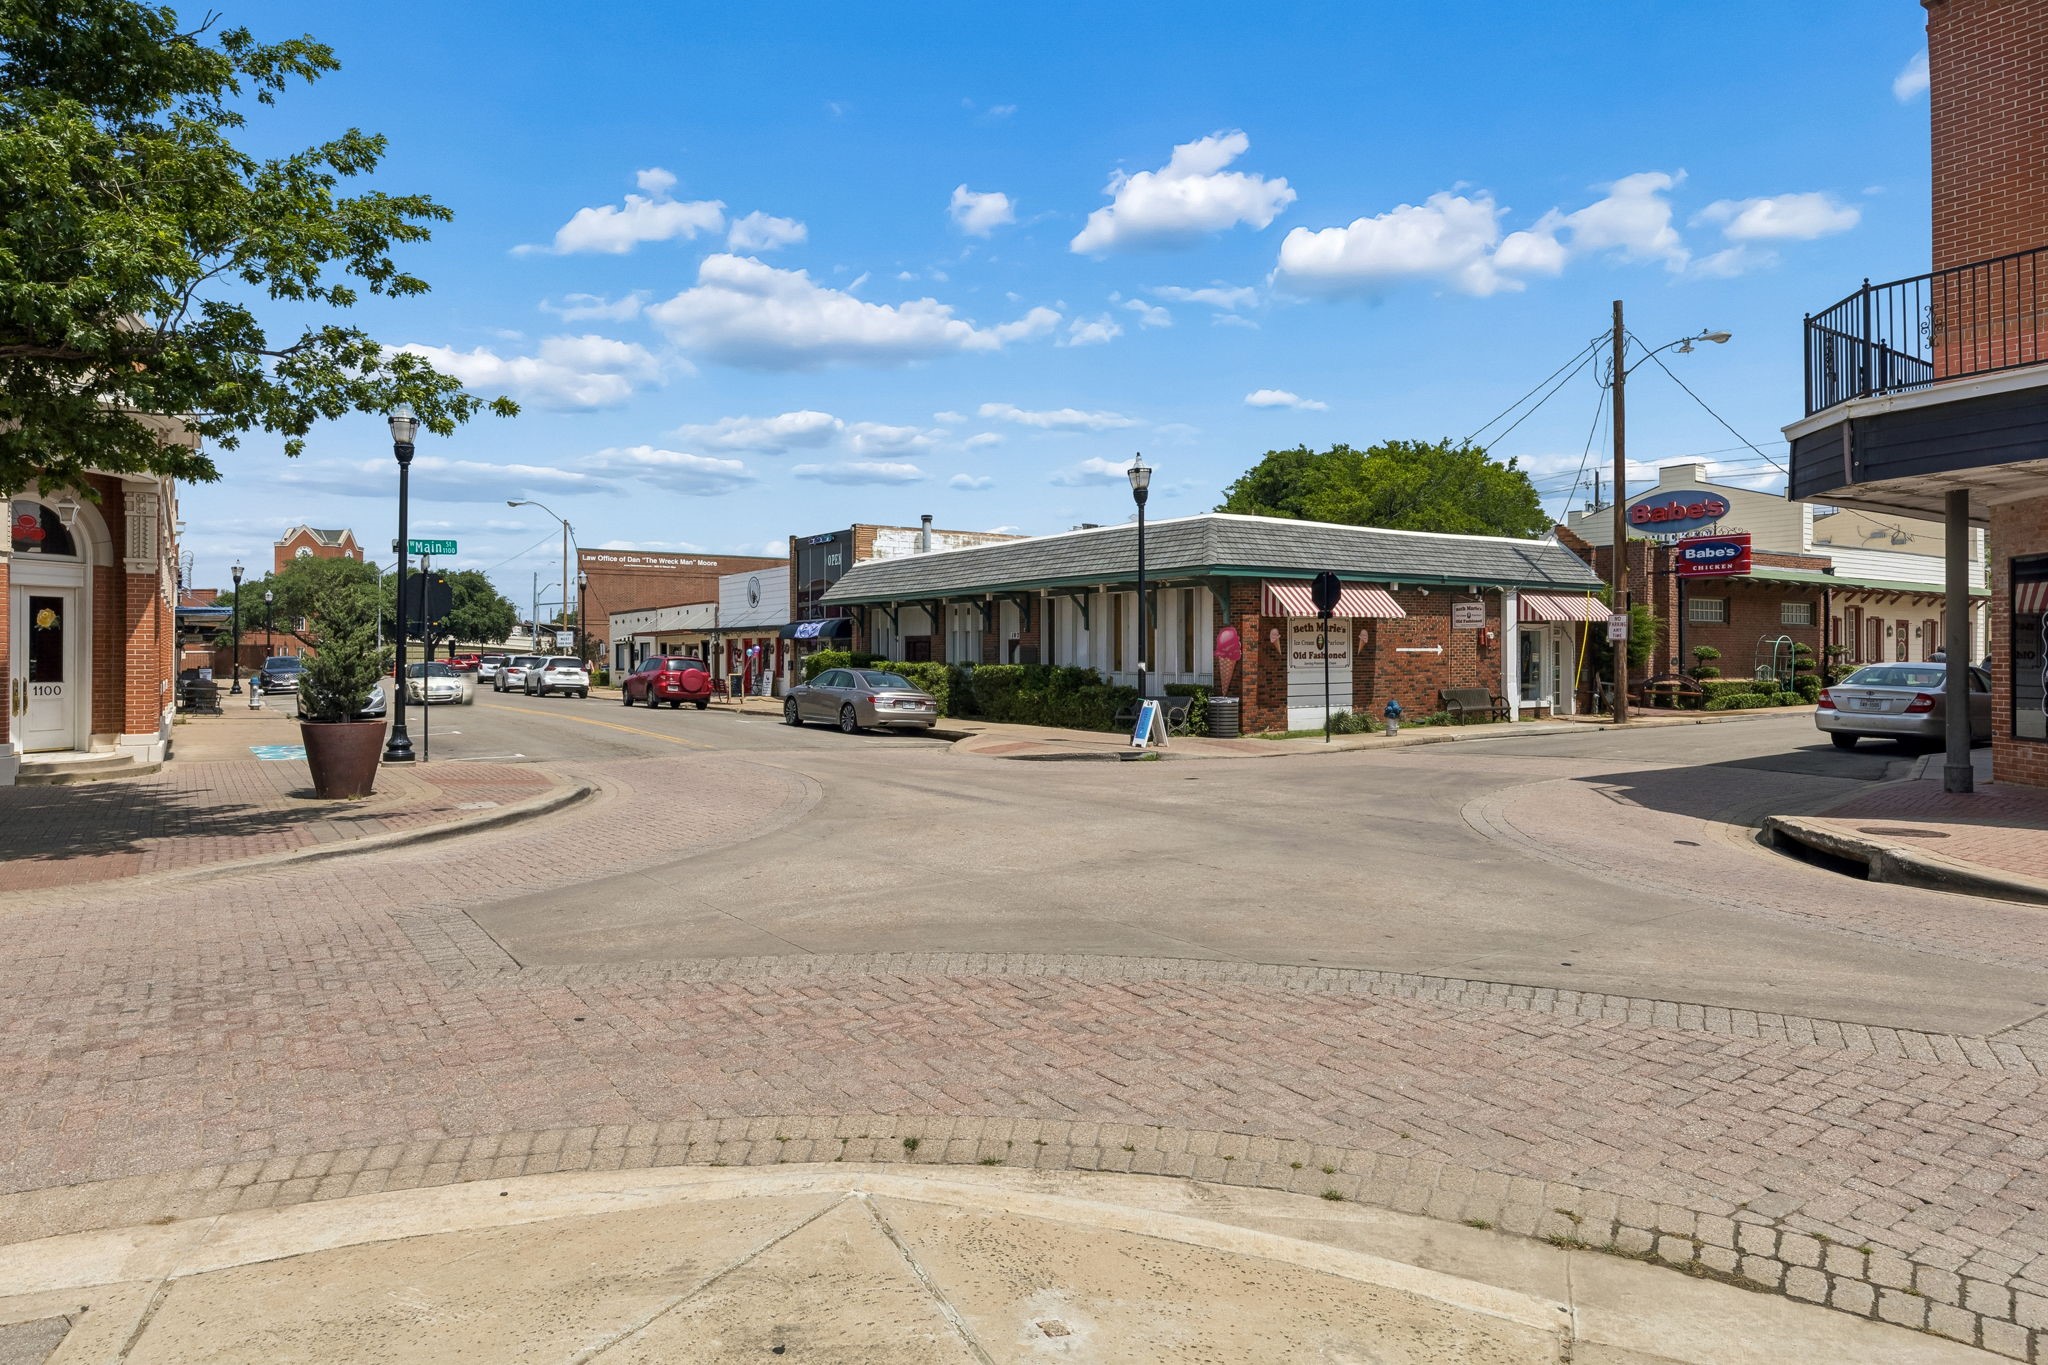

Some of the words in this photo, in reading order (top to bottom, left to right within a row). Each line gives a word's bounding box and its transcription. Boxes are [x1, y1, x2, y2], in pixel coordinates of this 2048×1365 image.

[1631, 499, 1724, 524] Babe's
[415, 541, 442, 553] Main
[1685, 547, 1736, 560] Babe's
[597, 554, 618, 562] Office
[658, 557, 679, 565] Wreck
[697, 559, 718, 567] Moore
[1692, 563, 1733, 571] CHICKEN
[1293, 623, 1314, 633] Beth
[1316, 622, 1346, 633] Mrie's
[1293, 651, 1307, 660] Old
[1308, 651, 1347, 660] Fashoned
[33, 685, 62, 696] 1100
